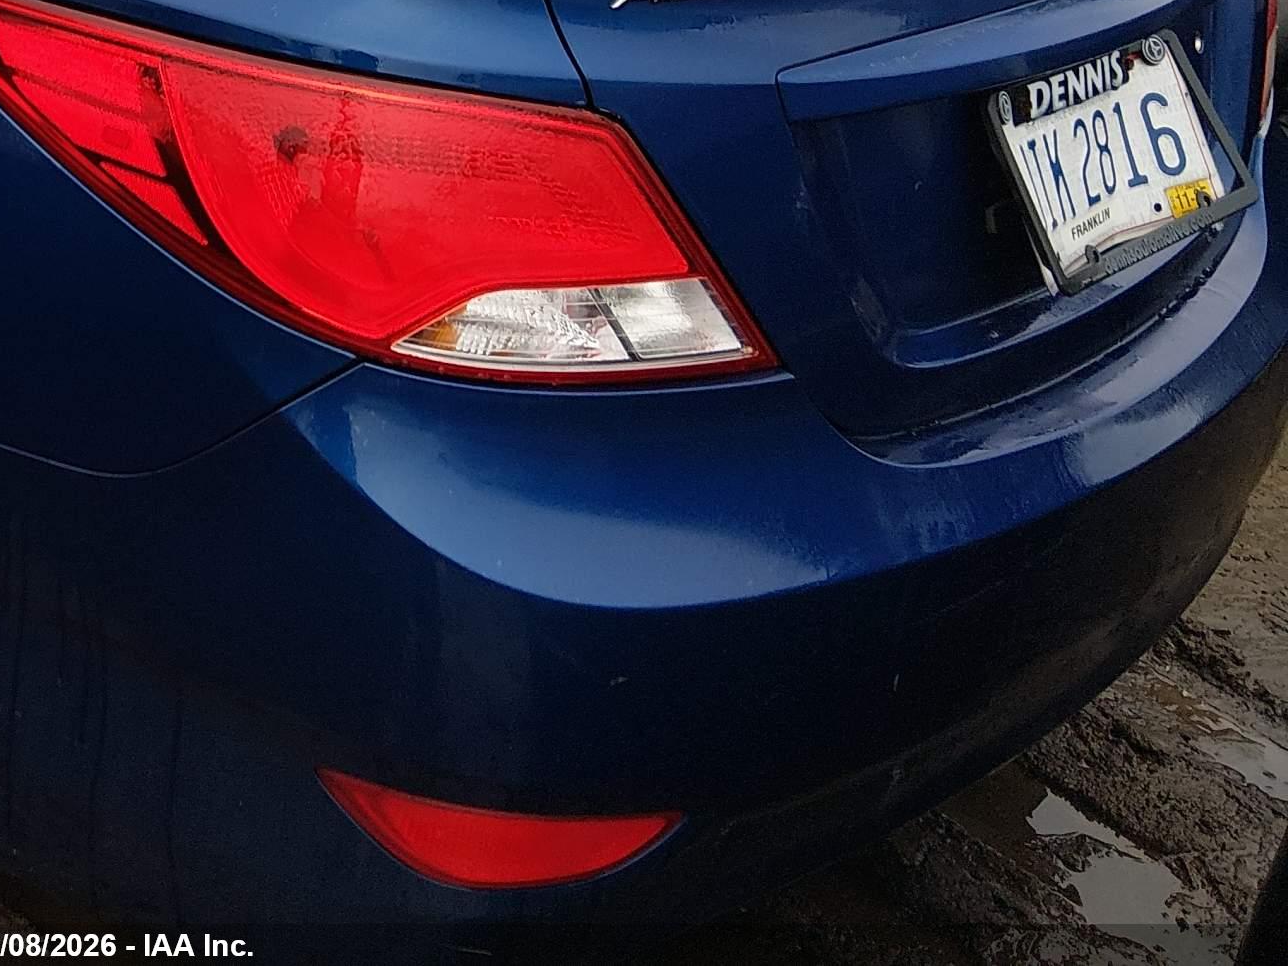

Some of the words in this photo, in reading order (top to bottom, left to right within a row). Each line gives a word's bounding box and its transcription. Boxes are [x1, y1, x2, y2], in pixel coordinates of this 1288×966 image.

[1027, 50, 1125, 118] DENNIS
[1073, 92, 1187, 211] 2816
[1071, 207, 1112, 240] FRANKLIN
